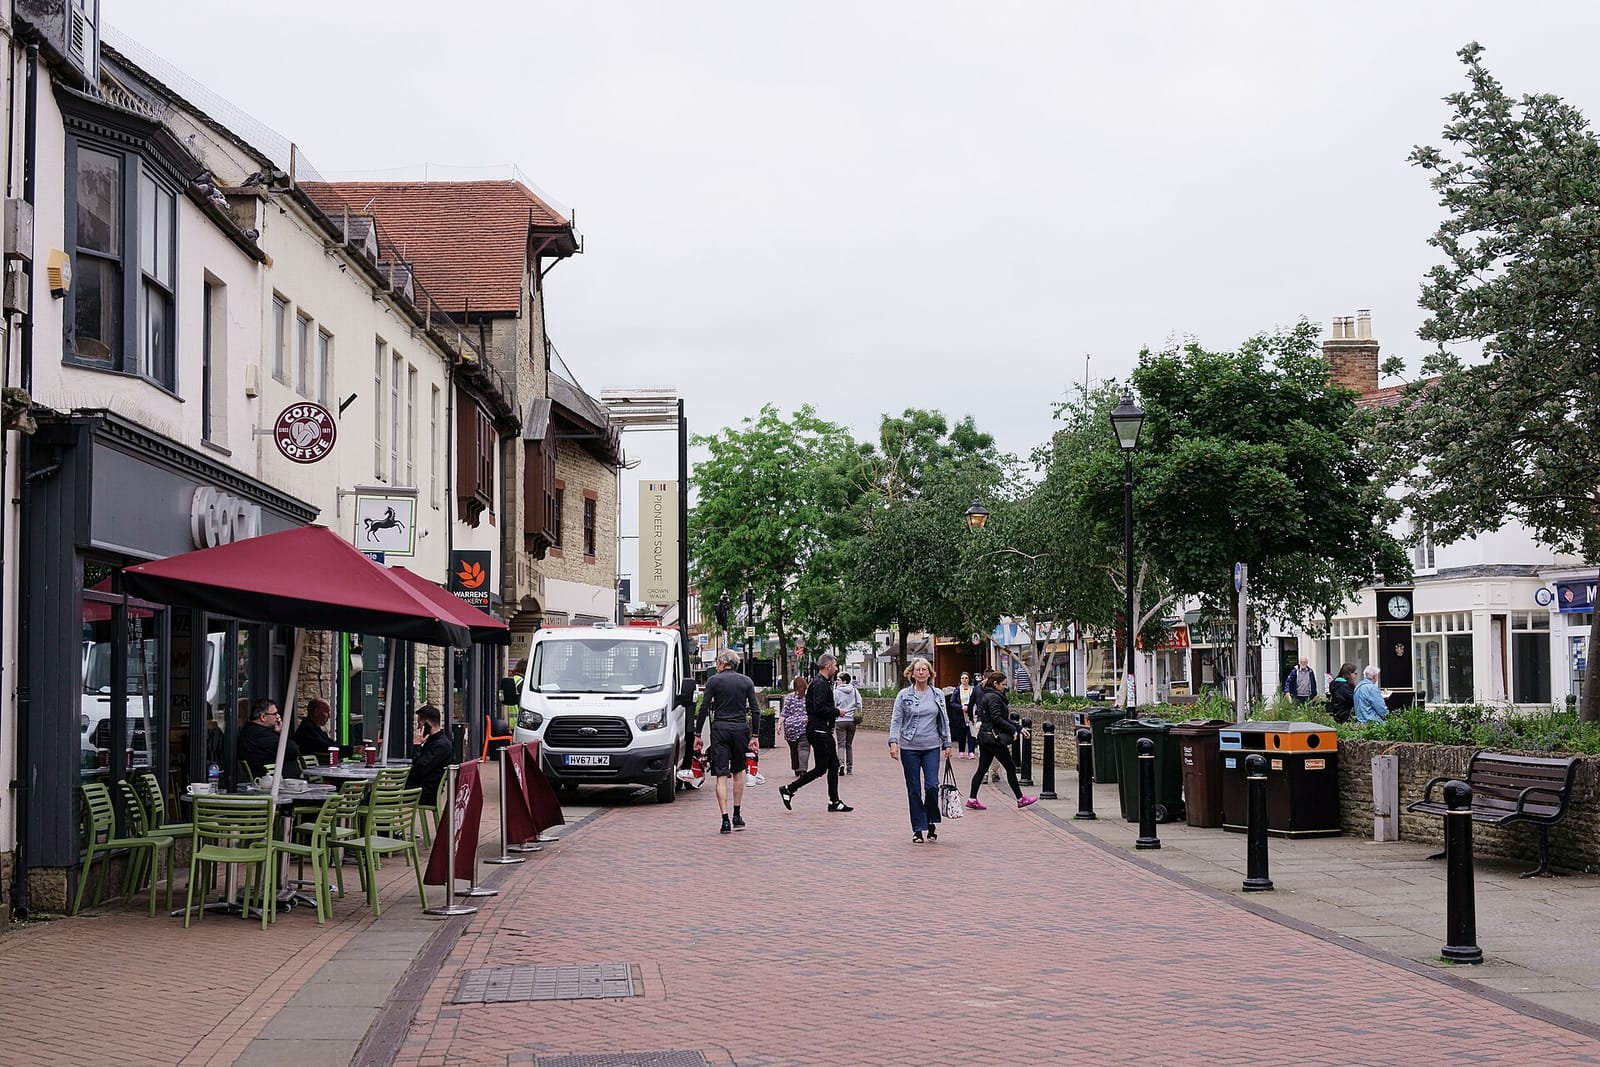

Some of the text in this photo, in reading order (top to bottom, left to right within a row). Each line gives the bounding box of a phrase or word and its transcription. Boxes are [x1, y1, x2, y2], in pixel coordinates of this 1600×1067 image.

[284, 407, 325, 424] COSTA
[281, 438, 329, 459] COFFEE
[653, 494, 663, 581] PIONEER SQUARE
[570, 756, 591, 765] HV67
